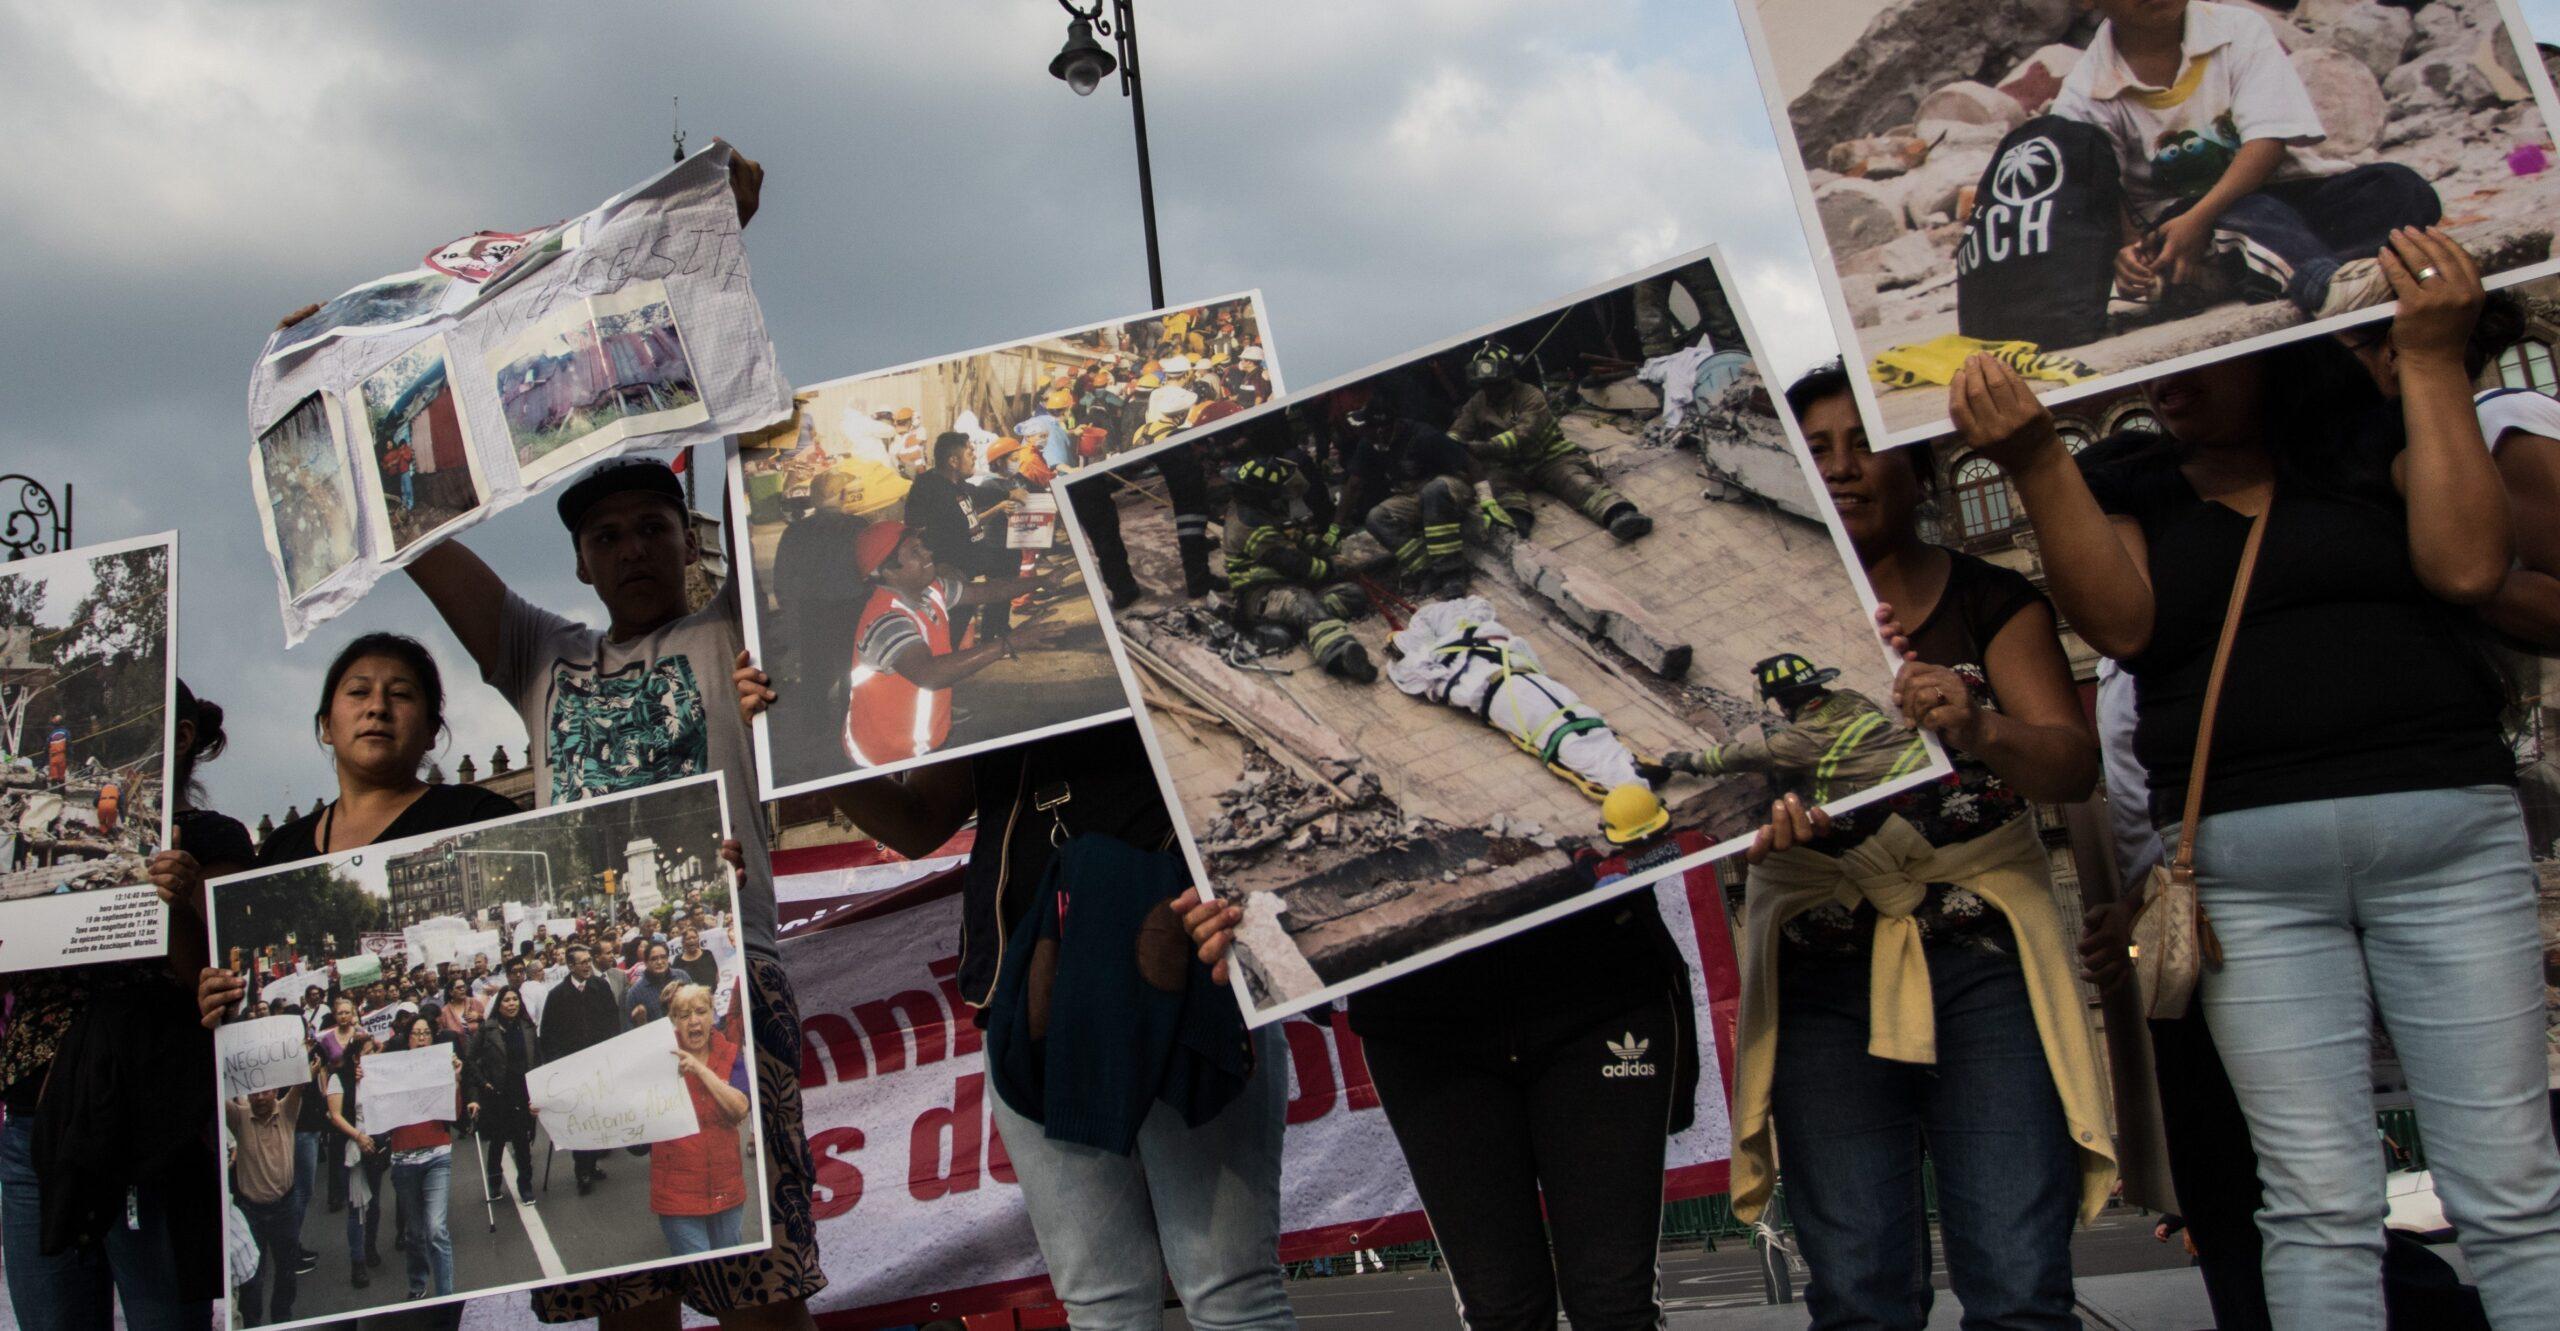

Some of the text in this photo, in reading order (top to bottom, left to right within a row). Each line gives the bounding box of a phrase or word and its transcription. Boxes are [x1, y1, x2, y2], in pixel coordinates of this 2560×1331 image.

[113, 903, 127, 911] local
[128, 901, 137, 909] del
[102, 911, 134, 922] septiembre
[143, 908, 159, 917] 2017
[79, 934, 105, 944] epicentro
[146, 928, 156, 936] km
[90, 944, 98, 952] de
[225, 1037, 299, 1073] NEGOCIO
[1602, 1061, 1656, 1078] adidas
[231, 1067, 266, 1096] NO
